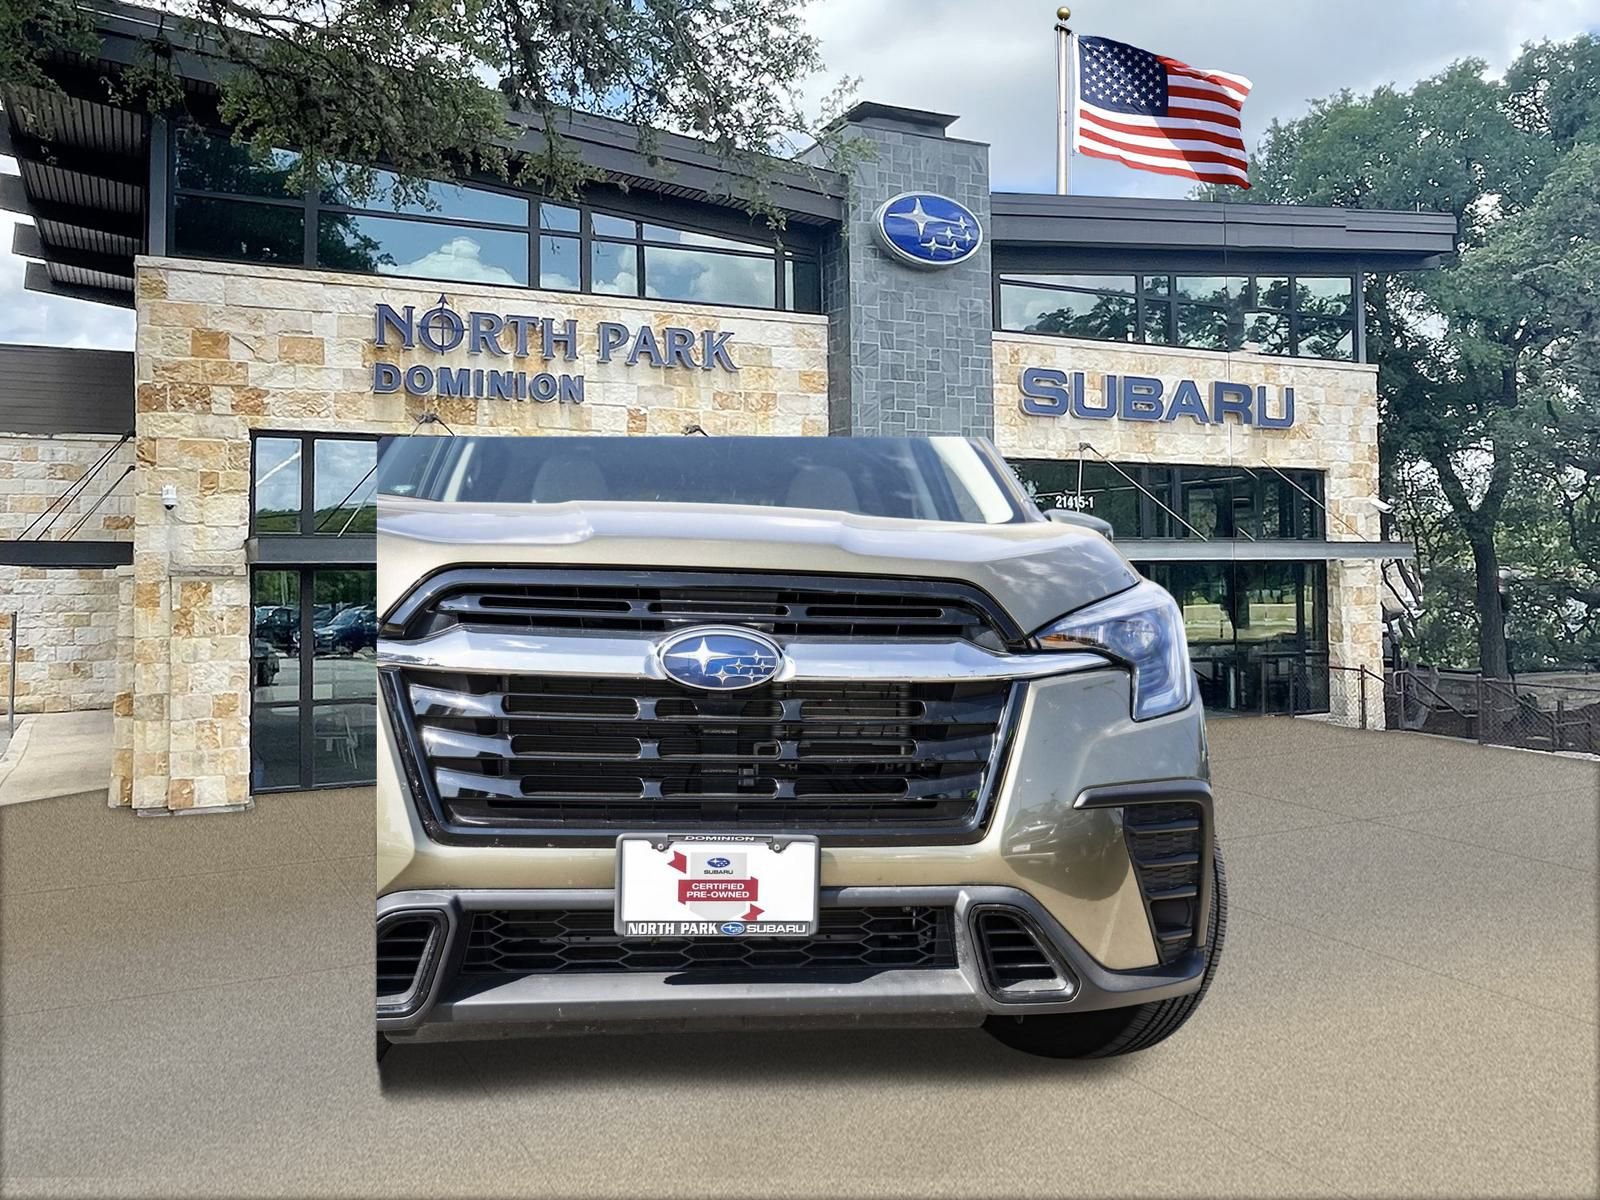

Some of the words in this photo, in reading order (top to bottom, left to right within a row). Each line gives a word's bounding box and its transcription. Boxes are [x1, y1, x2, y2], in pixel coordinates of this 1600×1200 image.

[375, 296, 578, 361] NORTH
[598, 321, 740, 373] PARK
[373, 362, 585, 404] DOMINION
[1019, 367, 1295, 429] SUBARU
[686, 890, 750, 899] PRE-OWNED
[691, 882, 745, 891] CERTIFIED
[627, 922, 675, 935] NORTH
[680, 922, 718, 935] PARK
[746, 924, 806, 933] SUBARU
